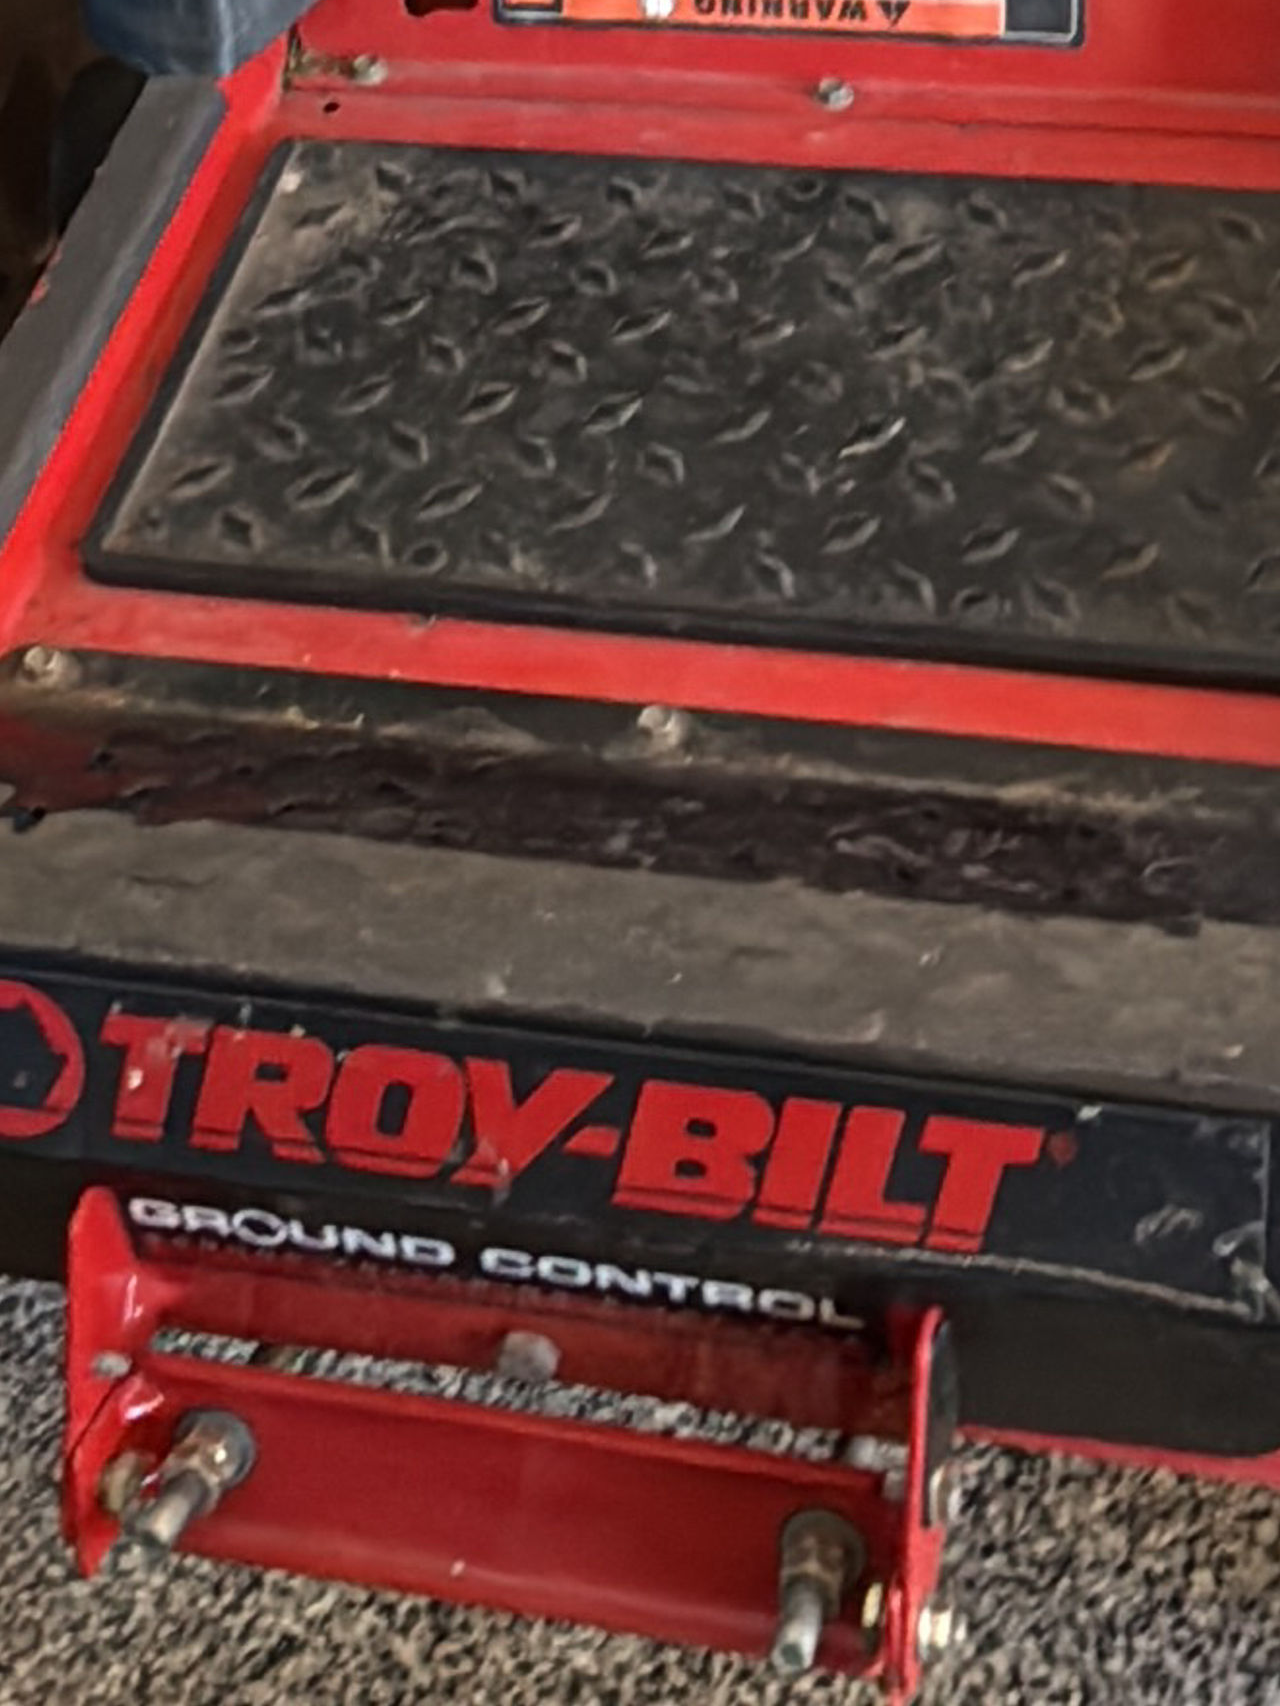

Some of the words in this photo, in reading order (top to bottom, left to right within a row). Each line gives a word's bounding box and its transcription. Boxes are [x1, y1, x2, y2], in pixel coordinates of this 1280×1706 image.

[99, 1011, 1049, 1253] TROY-BILT
[128, 1196, 456, 1268] GROUND
[480, 1249, 867, 1331] CONTROL
